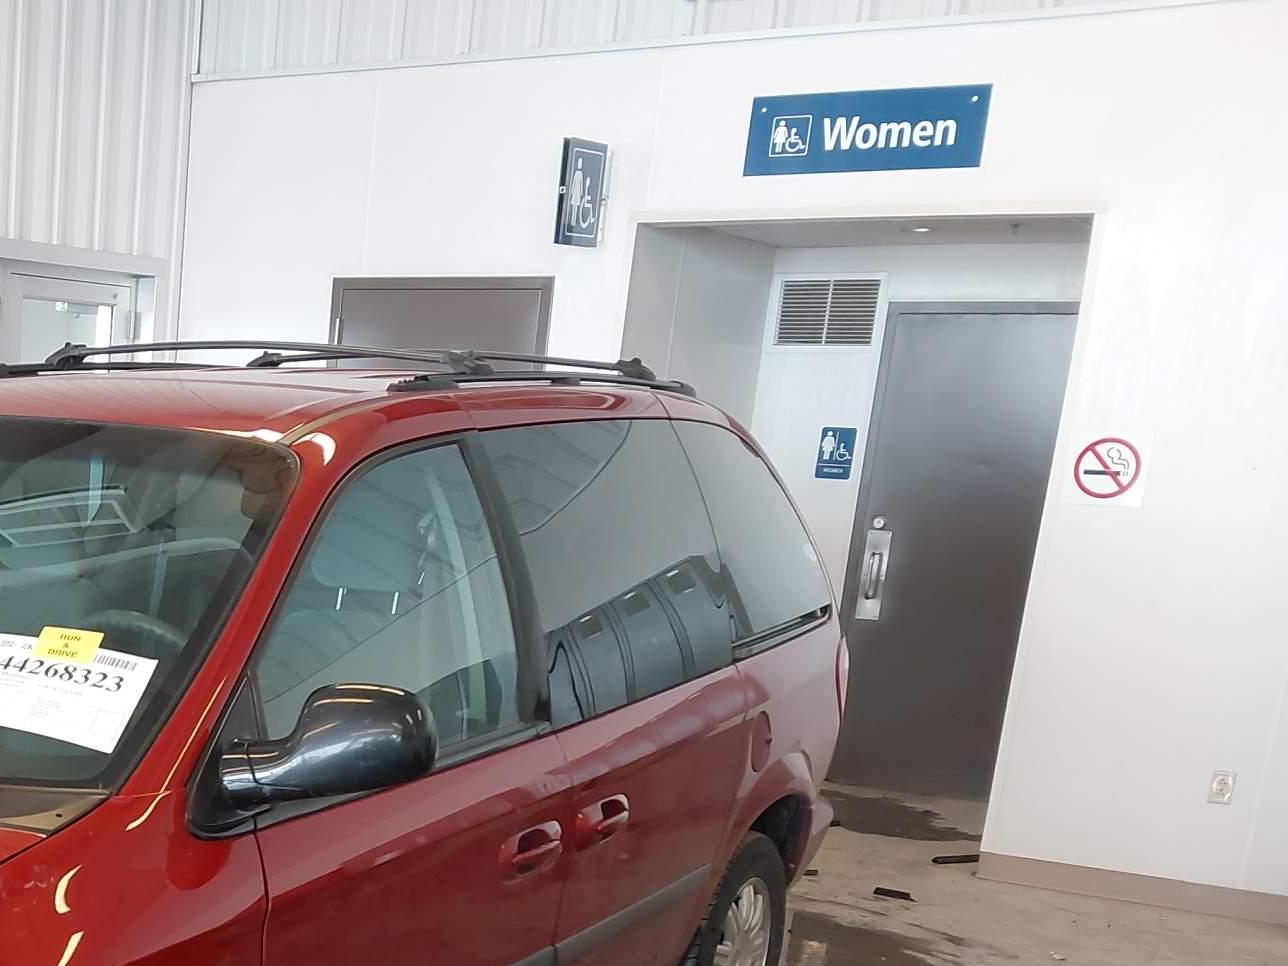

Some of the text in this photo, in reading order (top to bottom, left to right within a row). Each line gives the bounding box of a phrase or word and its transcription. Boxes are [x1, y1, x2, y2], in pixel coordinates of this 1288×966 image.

[823, 116, 957, 151] Women
[59, 633, 81, 642] RUN
[47, 648, 78, 658] DRIVE
